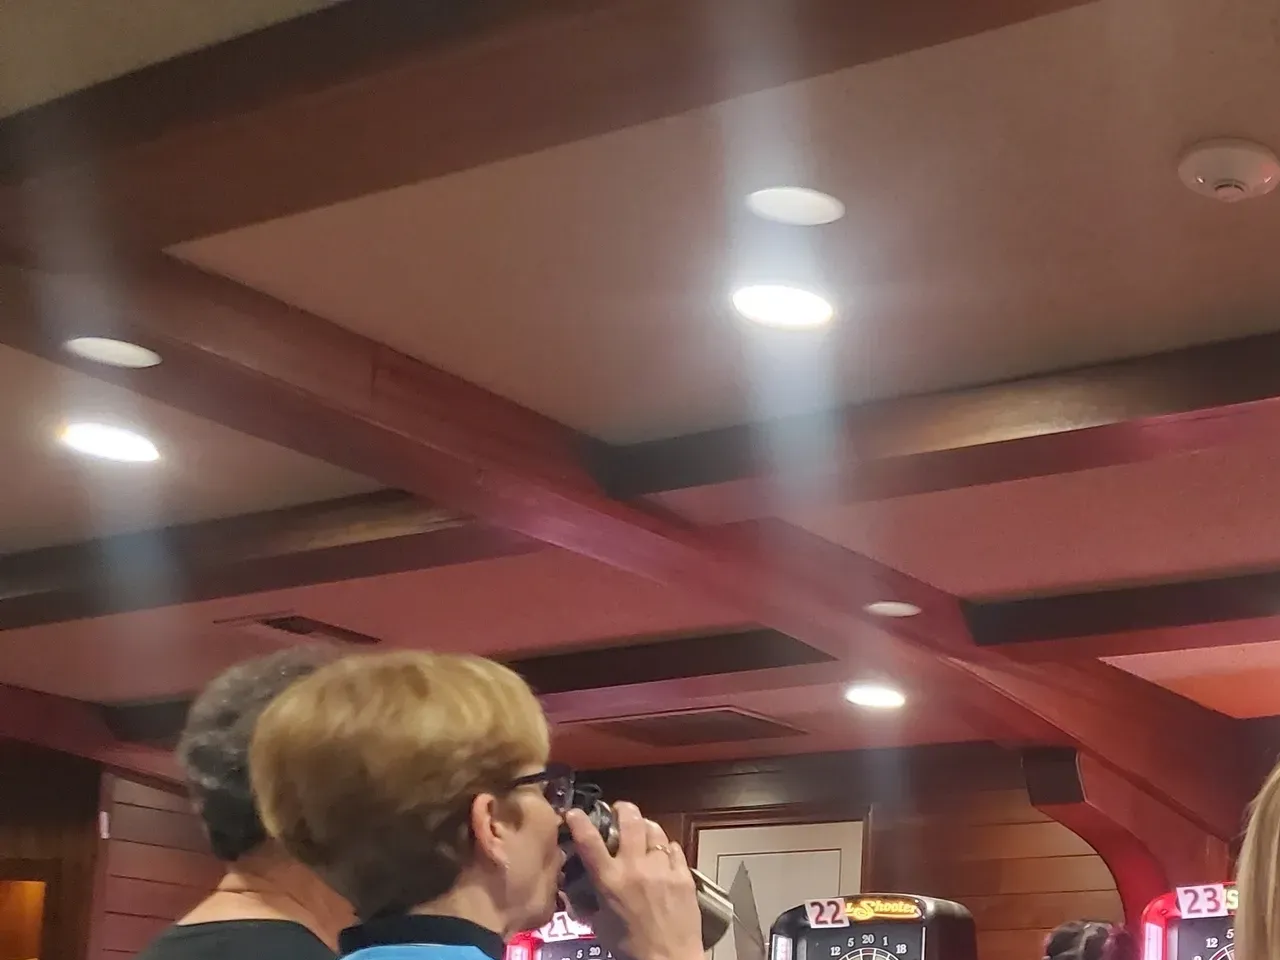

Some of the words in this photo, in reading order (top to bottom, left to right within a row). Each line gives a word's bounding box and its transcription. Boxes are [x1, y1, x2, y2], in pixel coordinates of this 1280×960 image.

[1184, 887, 1220, 914] 23
[810, 901, 844, 925] 22
[847, 938, 854, 947] 5
[862, 934, 874, 943] 20
[883, 937, 888, 945] 1
[1206, 938, 1218, 948] 12
[830, 947, 841, 956] 12
[896, 944, 907, 954] 18
